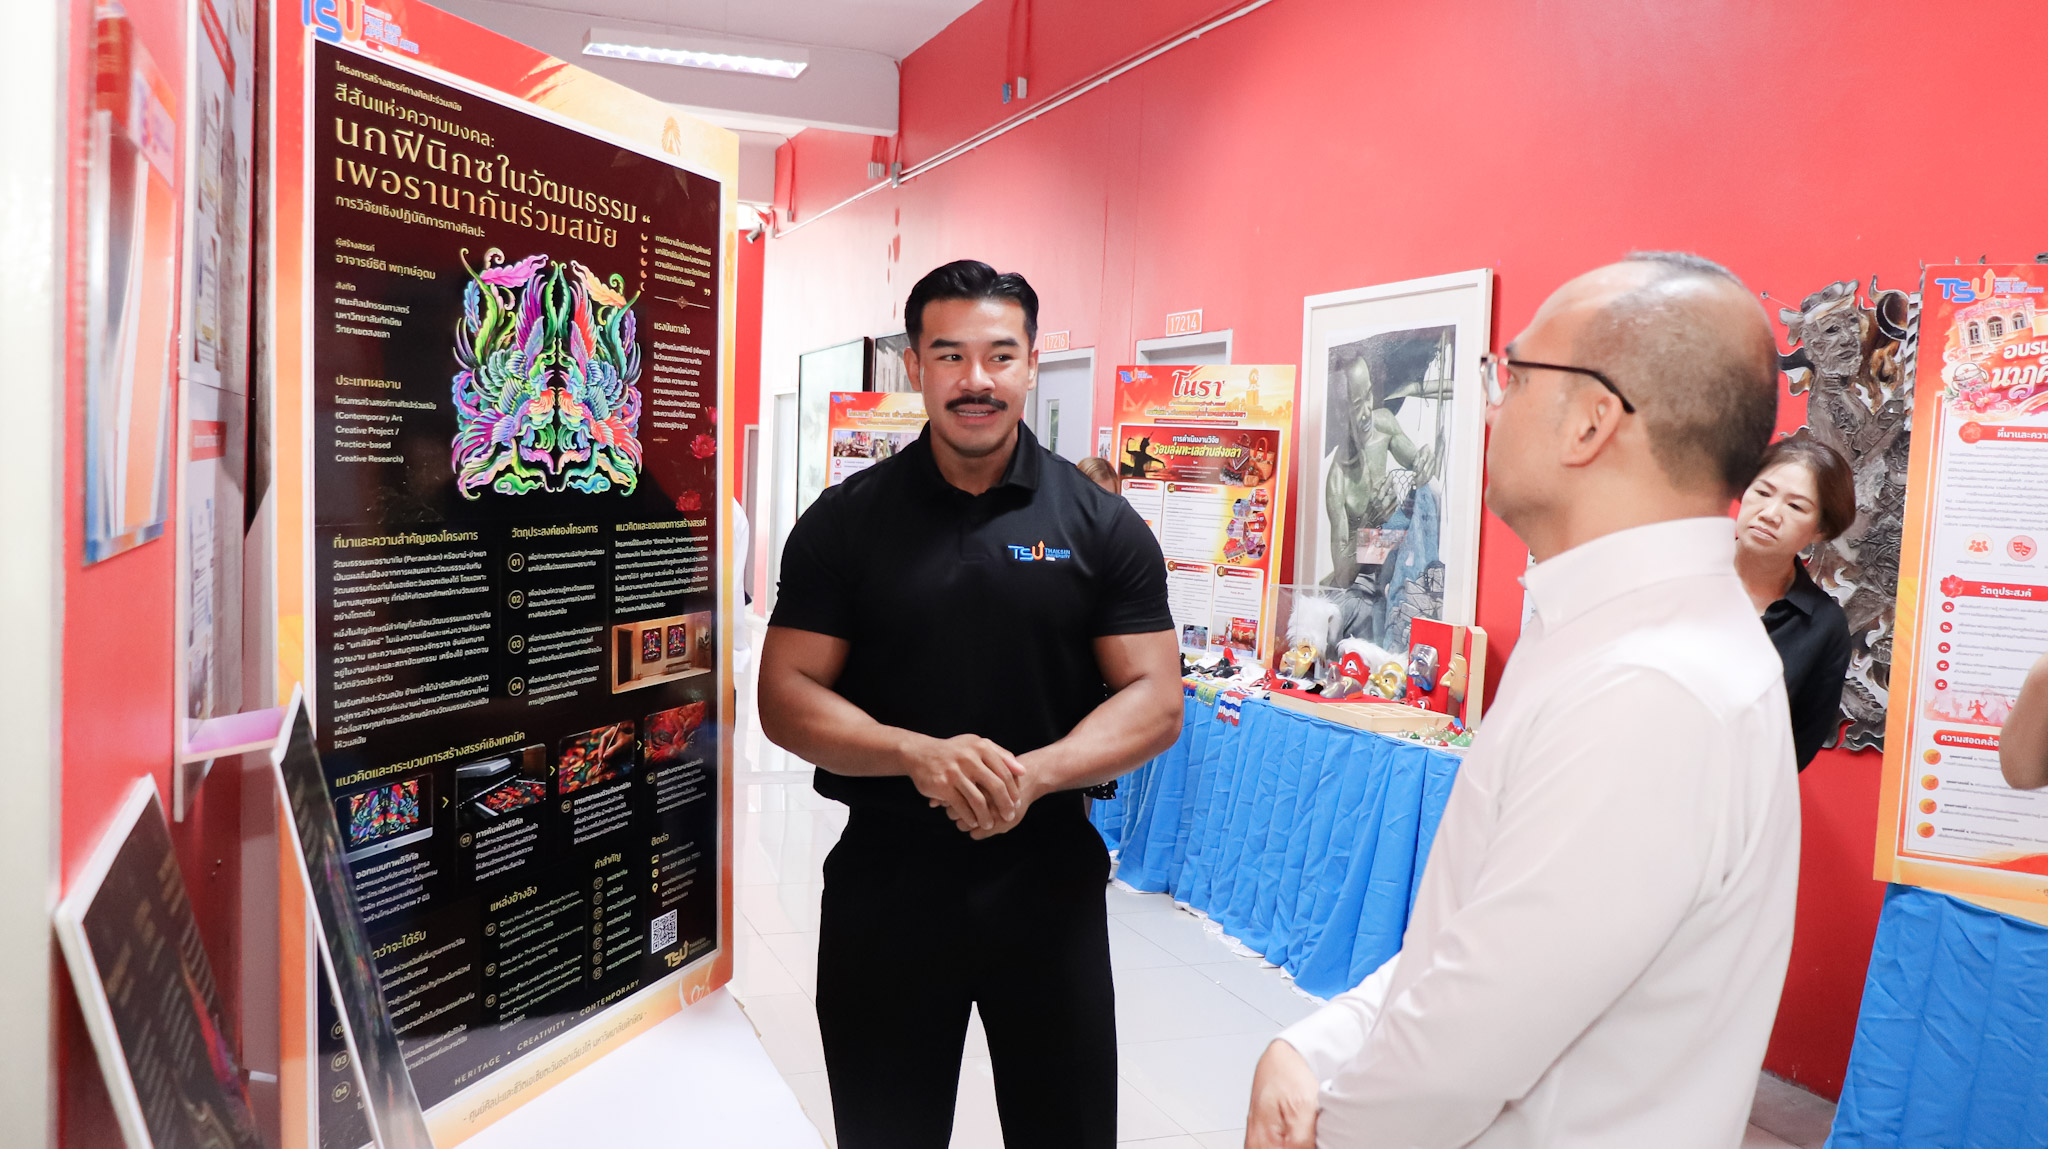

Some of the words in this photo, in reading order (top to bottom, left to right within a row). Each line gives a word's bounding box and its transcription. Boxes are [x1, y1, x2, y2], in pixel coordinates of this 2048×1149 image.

[335, 152, 616, 250] เพอรานากันร่วมสมัย
[335, 192, 485, 239] การวิจัยเชิงปฏิบัติการทางศิลปะ
[1935, 269, 1996, 303] TSU
[1170, 315, 1197, 333] 17214
[335, 374, 401, 389] ประเภทผลงาน
[1172, 370, 1225, 398] โนรา
[335, 411, 390, 422] (Contemporary
[335, 426, 367, 434] Creative
[368, 427, 394, 435] Project
[335, 440, 391, 449] Practice-based
[1154, 442, 1242, 460] รอบลุ่มทะเลสาบสงขลา
[335, 454, 367, 462] Creative
[368, 454, 404, 462] Research)
[333, 528, 478, 548] ที่มาและความสำคัญของโครงการ
[1007, 540, 1045, 561] TSU
[404, 553, 442, 563] (Peranakan)
[511, 558, 520, 566] 01
[511, 595, 520, 603] 02
[1981, 586, 2032, 598] วัตถุประสงค์
[511, 640, 521, 648] 03
[511, 682, 520, 690] 04
[1940, 733, 1999, 747] ความสอดคล้อ
[336, 730, 525, 787] แนวคิดและกระบวนการสร้างสรรค์เชิงเทคนิค
[490, 884, 536, 912] แหล่งอ้างอิง
[664, 940, 689, 967] TSU
[454, 1054, 501, 1086] HERITAGE
[517, 1020, 566, 1051] CREATIVITY
[579, 979, 640, 1016] CONTEMPORARY
[335, 1054, 346, 1067] 03
[335, 1085, 346, 1098] 04
